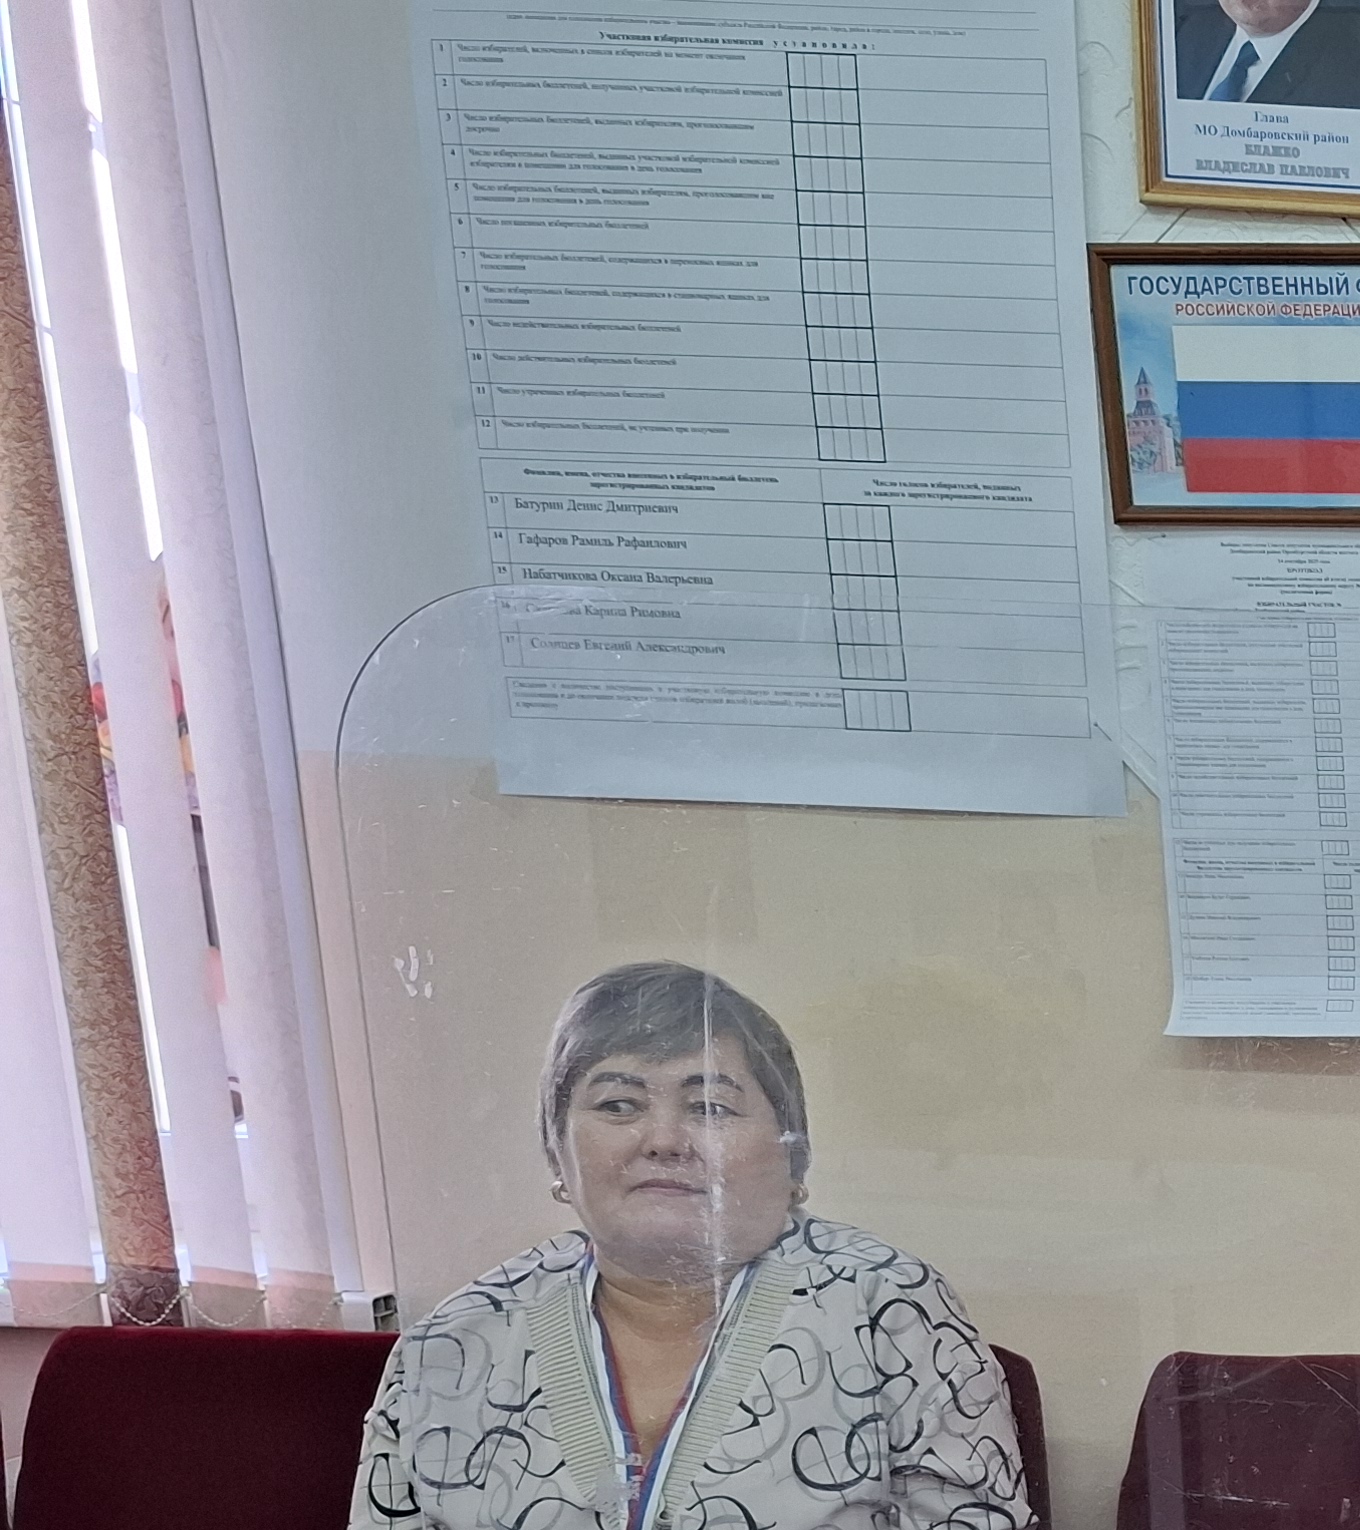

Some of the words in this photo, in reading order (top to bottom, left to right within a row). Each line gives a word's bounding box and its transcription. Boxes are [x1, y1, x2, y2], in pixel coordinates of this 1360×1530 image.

[1254, 111, 1289, 123] Глава
[1194, 124, 1218, 136] МО
[1221, 125, 1309, 142] Домбаровский
[1313, 133, 1349, 145] район
[1127, 272, 1349, 299] ГОСУДАРСТВЕННЫЙ
[1175, 300, 1277, 317] РОССИЙСКОЙ
[515, 497, 564, 513] Батурин
[567, 499, 603, 513] Денис
[605, 500, 679, 516] Дмитриевич
[518, 533, 569, 548] Гафаров
[571, 535, 614, 547] Рамиль
[616, 536, 688, 551] Рафаилович
[522, 568, 598, 583] Набатчикова
[601, 570, 643, 583] Оксана
[646, 571, 714, 587] Валерьевна
